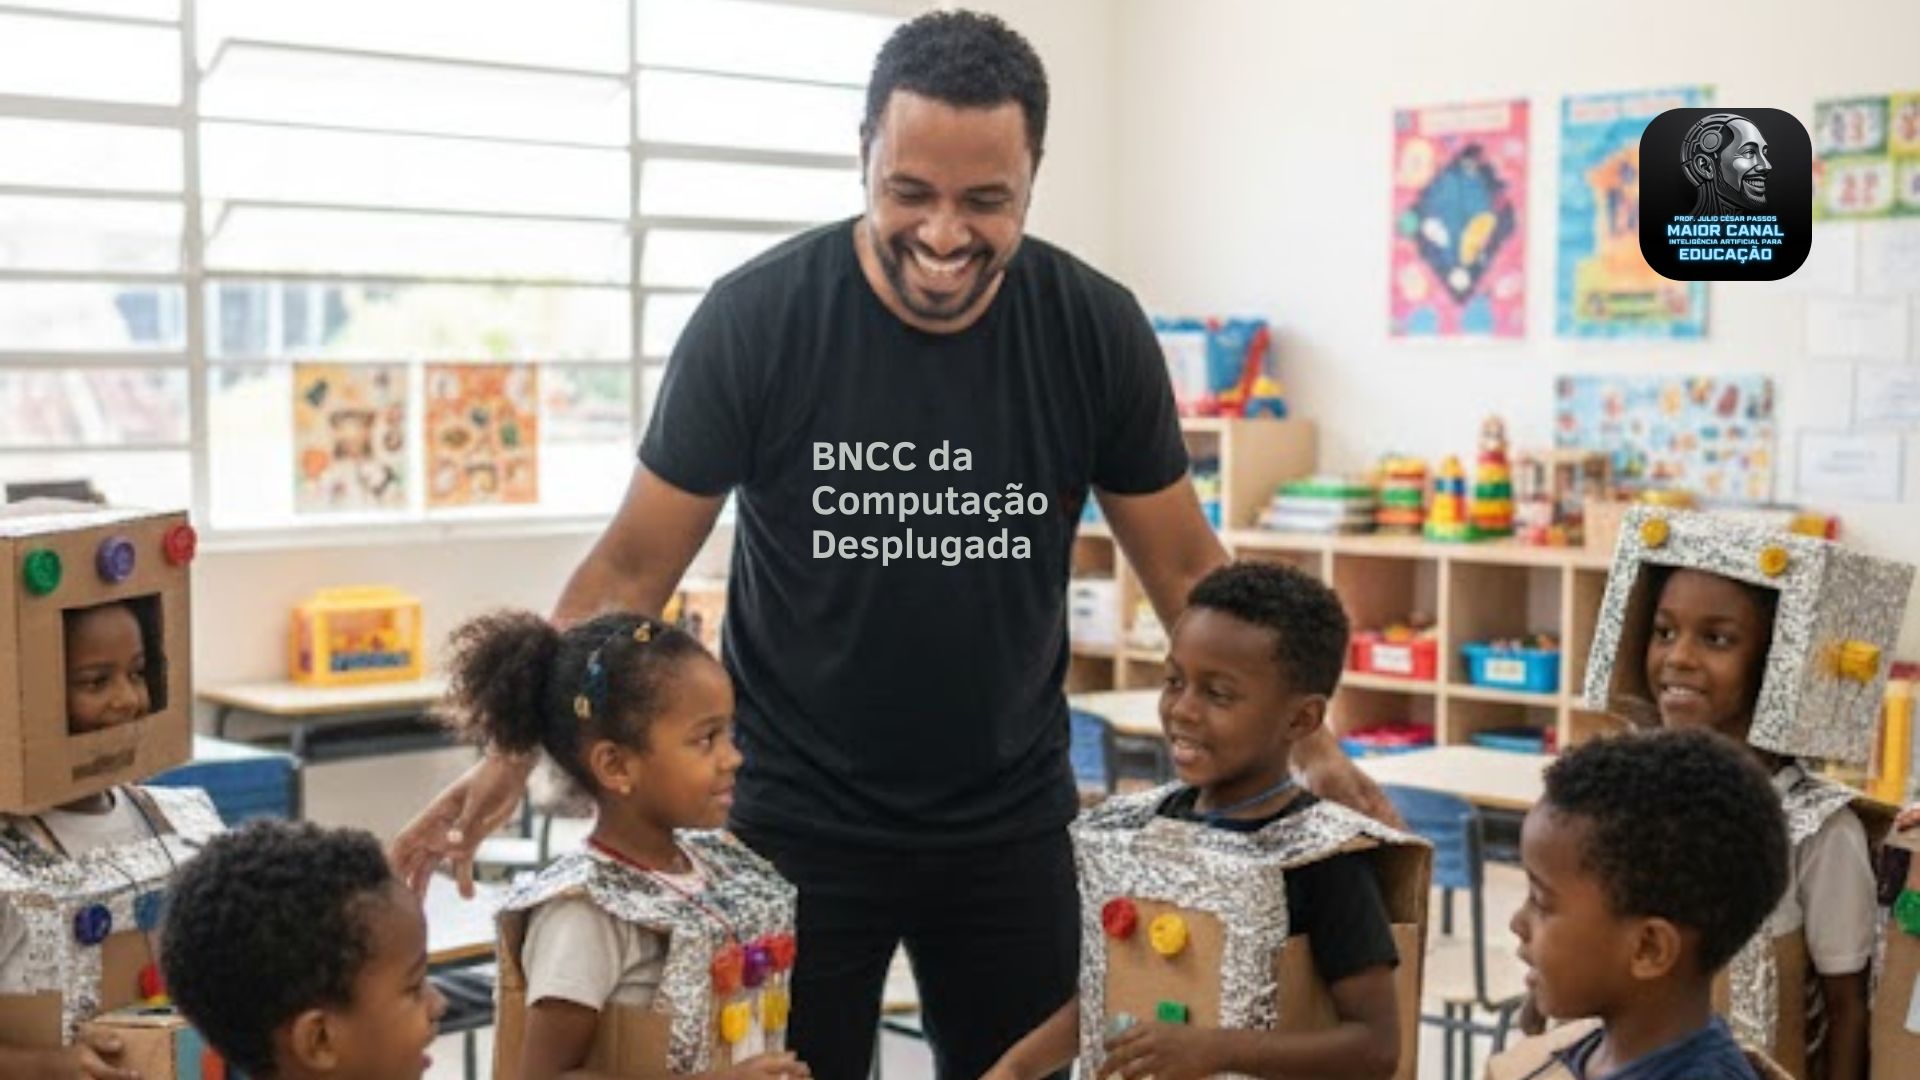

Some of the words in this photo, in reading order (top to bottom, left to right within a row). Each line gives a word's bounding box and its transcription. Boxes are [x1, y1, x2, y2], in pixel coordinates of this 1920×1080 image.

[813, 441, 917, 471] BNCC
[929, 440, 972, 471] da
[812, 483, 1048, 522] Computação
[813, 528, 1031, 566] Desplugada
